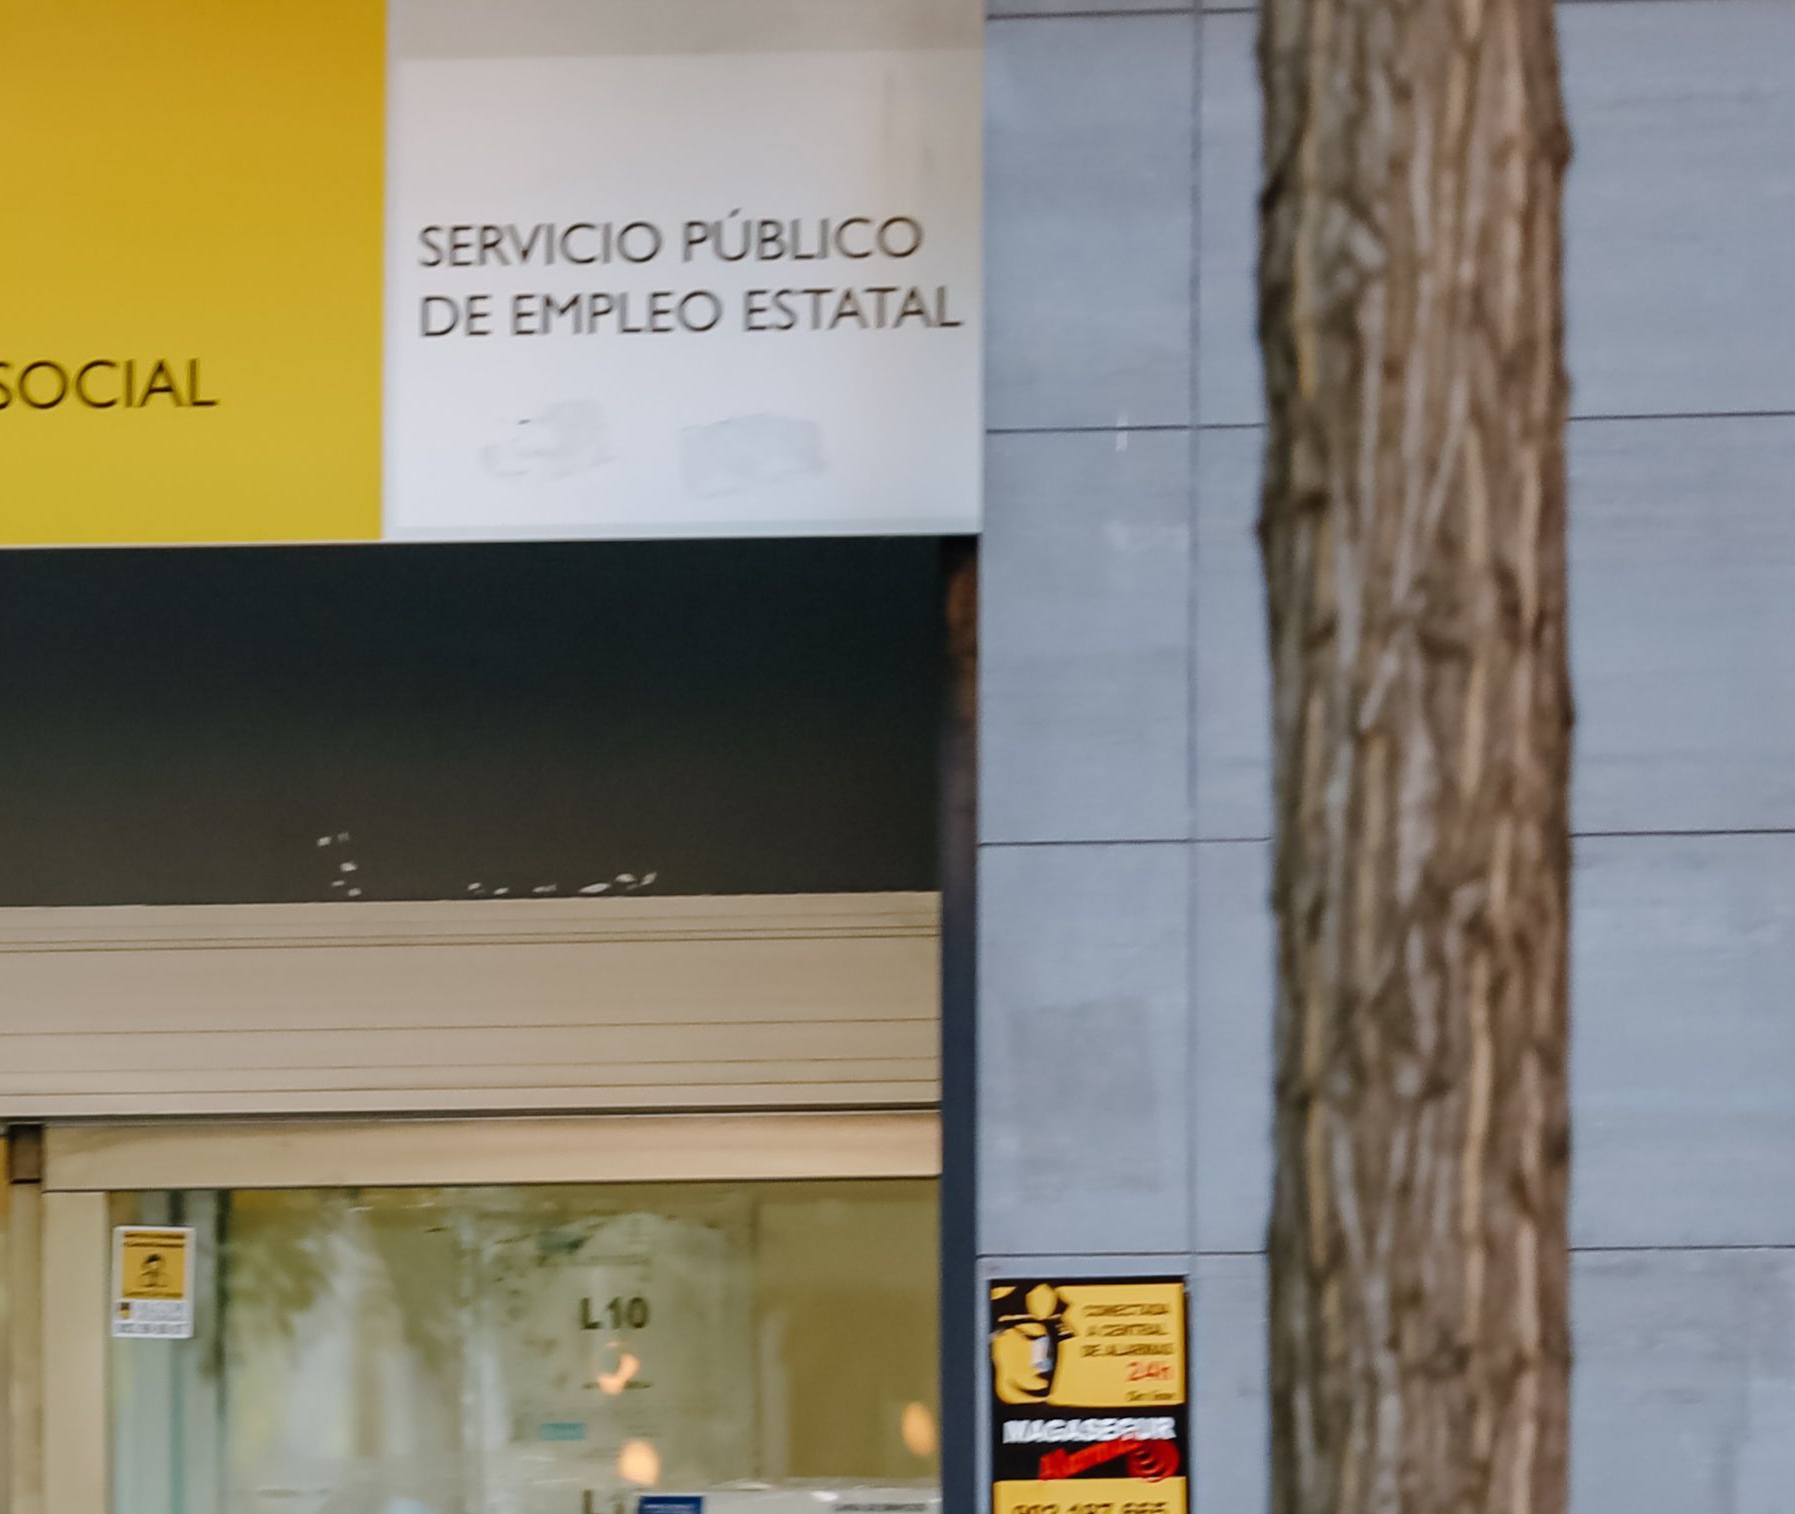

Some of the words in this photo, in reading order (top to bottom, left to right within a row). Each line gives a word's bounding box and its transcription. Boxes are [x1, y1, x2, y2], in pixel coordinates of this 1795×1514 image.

[418, 221, 664, 268] SERVICIO
[681, 207, 924, 263] PÚBLICO
[419, 294, 493, 338] DE
[511, 289, 724, 337] EMPLEO
[743, 286, 965, 332] ESTATAL
[579, 1296, 650, 1330] L10
[1101, 1323, 1170, 1337] CENTRAL
